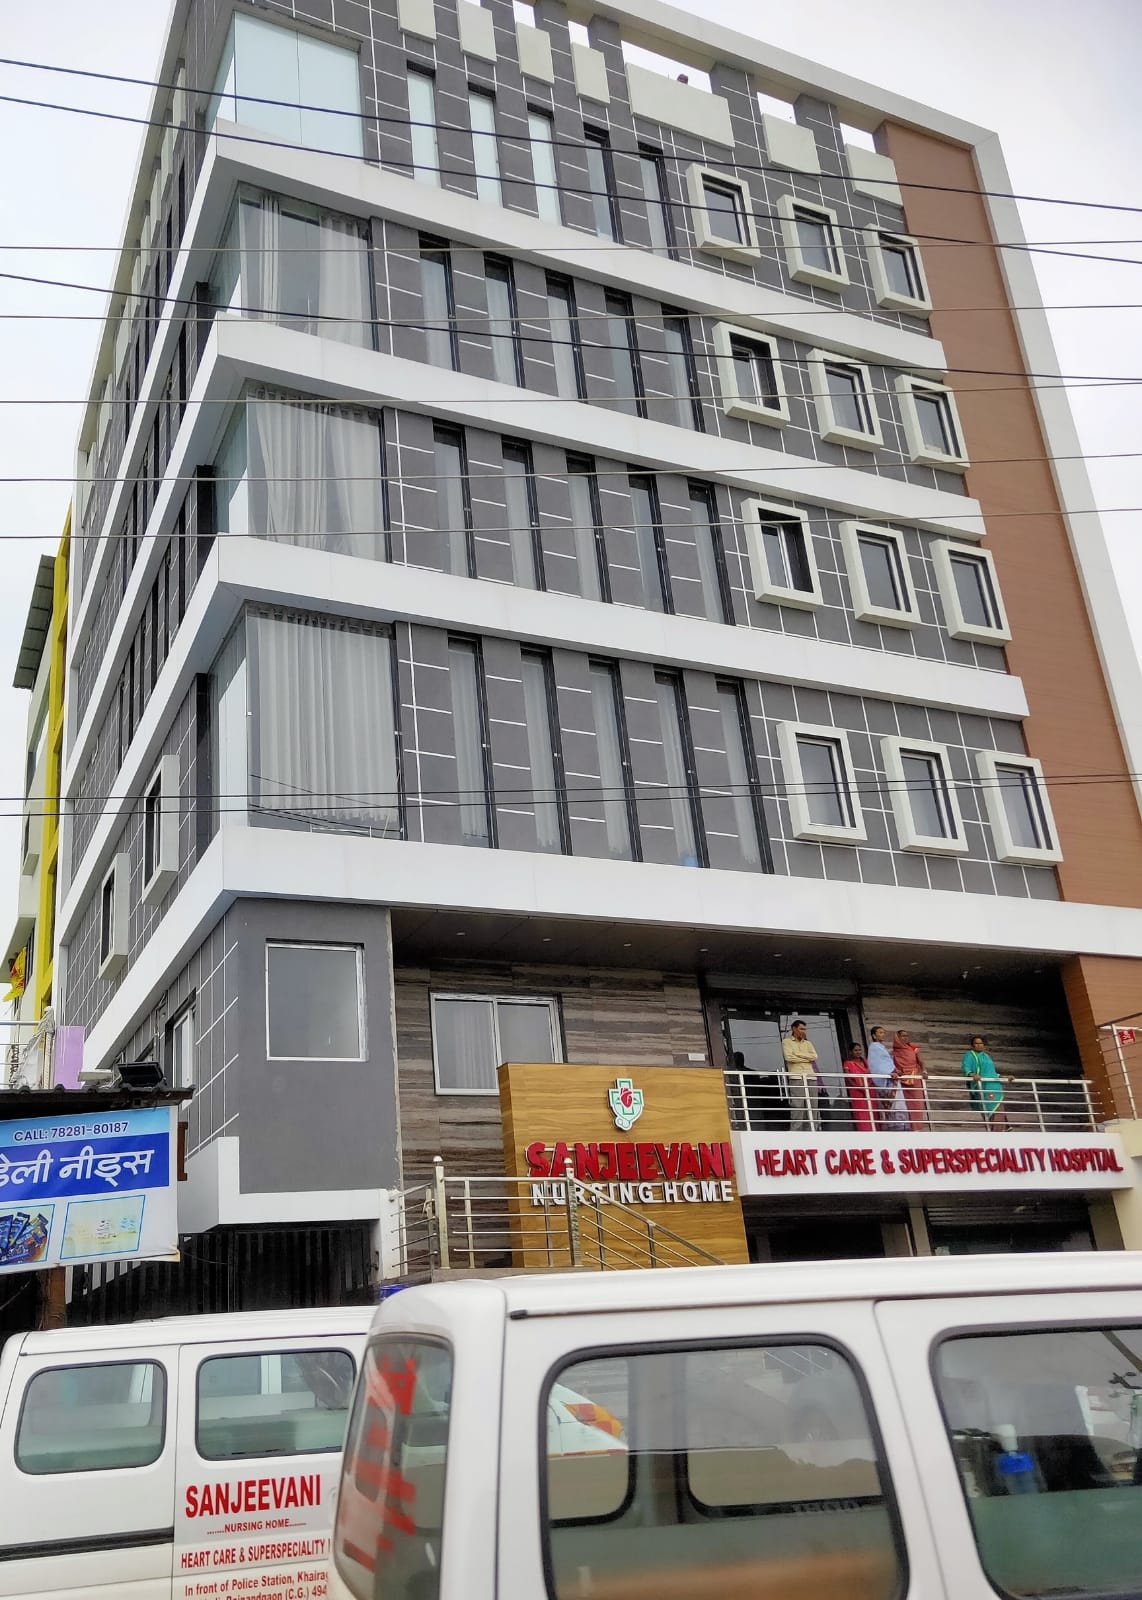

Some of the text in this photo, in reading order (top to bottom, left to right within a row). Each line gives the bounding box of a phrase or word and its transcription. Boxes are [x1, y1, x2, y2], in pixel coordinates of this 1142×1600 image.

[14, 1122, 128, 1142] CALL: 78281-80187
[59, 1145, 155, 1187] नीड्स
[525, 1141, 735, 1180] SANJEEVANI
[755, 1147, 1124, 1177] HEART CARE & SUPERSPECIALITY HOSPITAL
[531, 1180, 734, 1206] NURSING HOME
[185, 1474, 321, 1518] SANJEEVANI
[181, 1551, 210, 1568] HEART
[213, 1548, 236, 1566] CARE
[239, 1547, 245, 1563] &
[248, 1539, 326, 1563] SUPERSPECIALITY
[185, 1585, 193, 1597] In
[196, 1582, 217, 1595] front
[220, 1580, 229, 1592] of
[232, 1577, 259, 1590] Police
[261, 1574, 294, 1587] Station,
